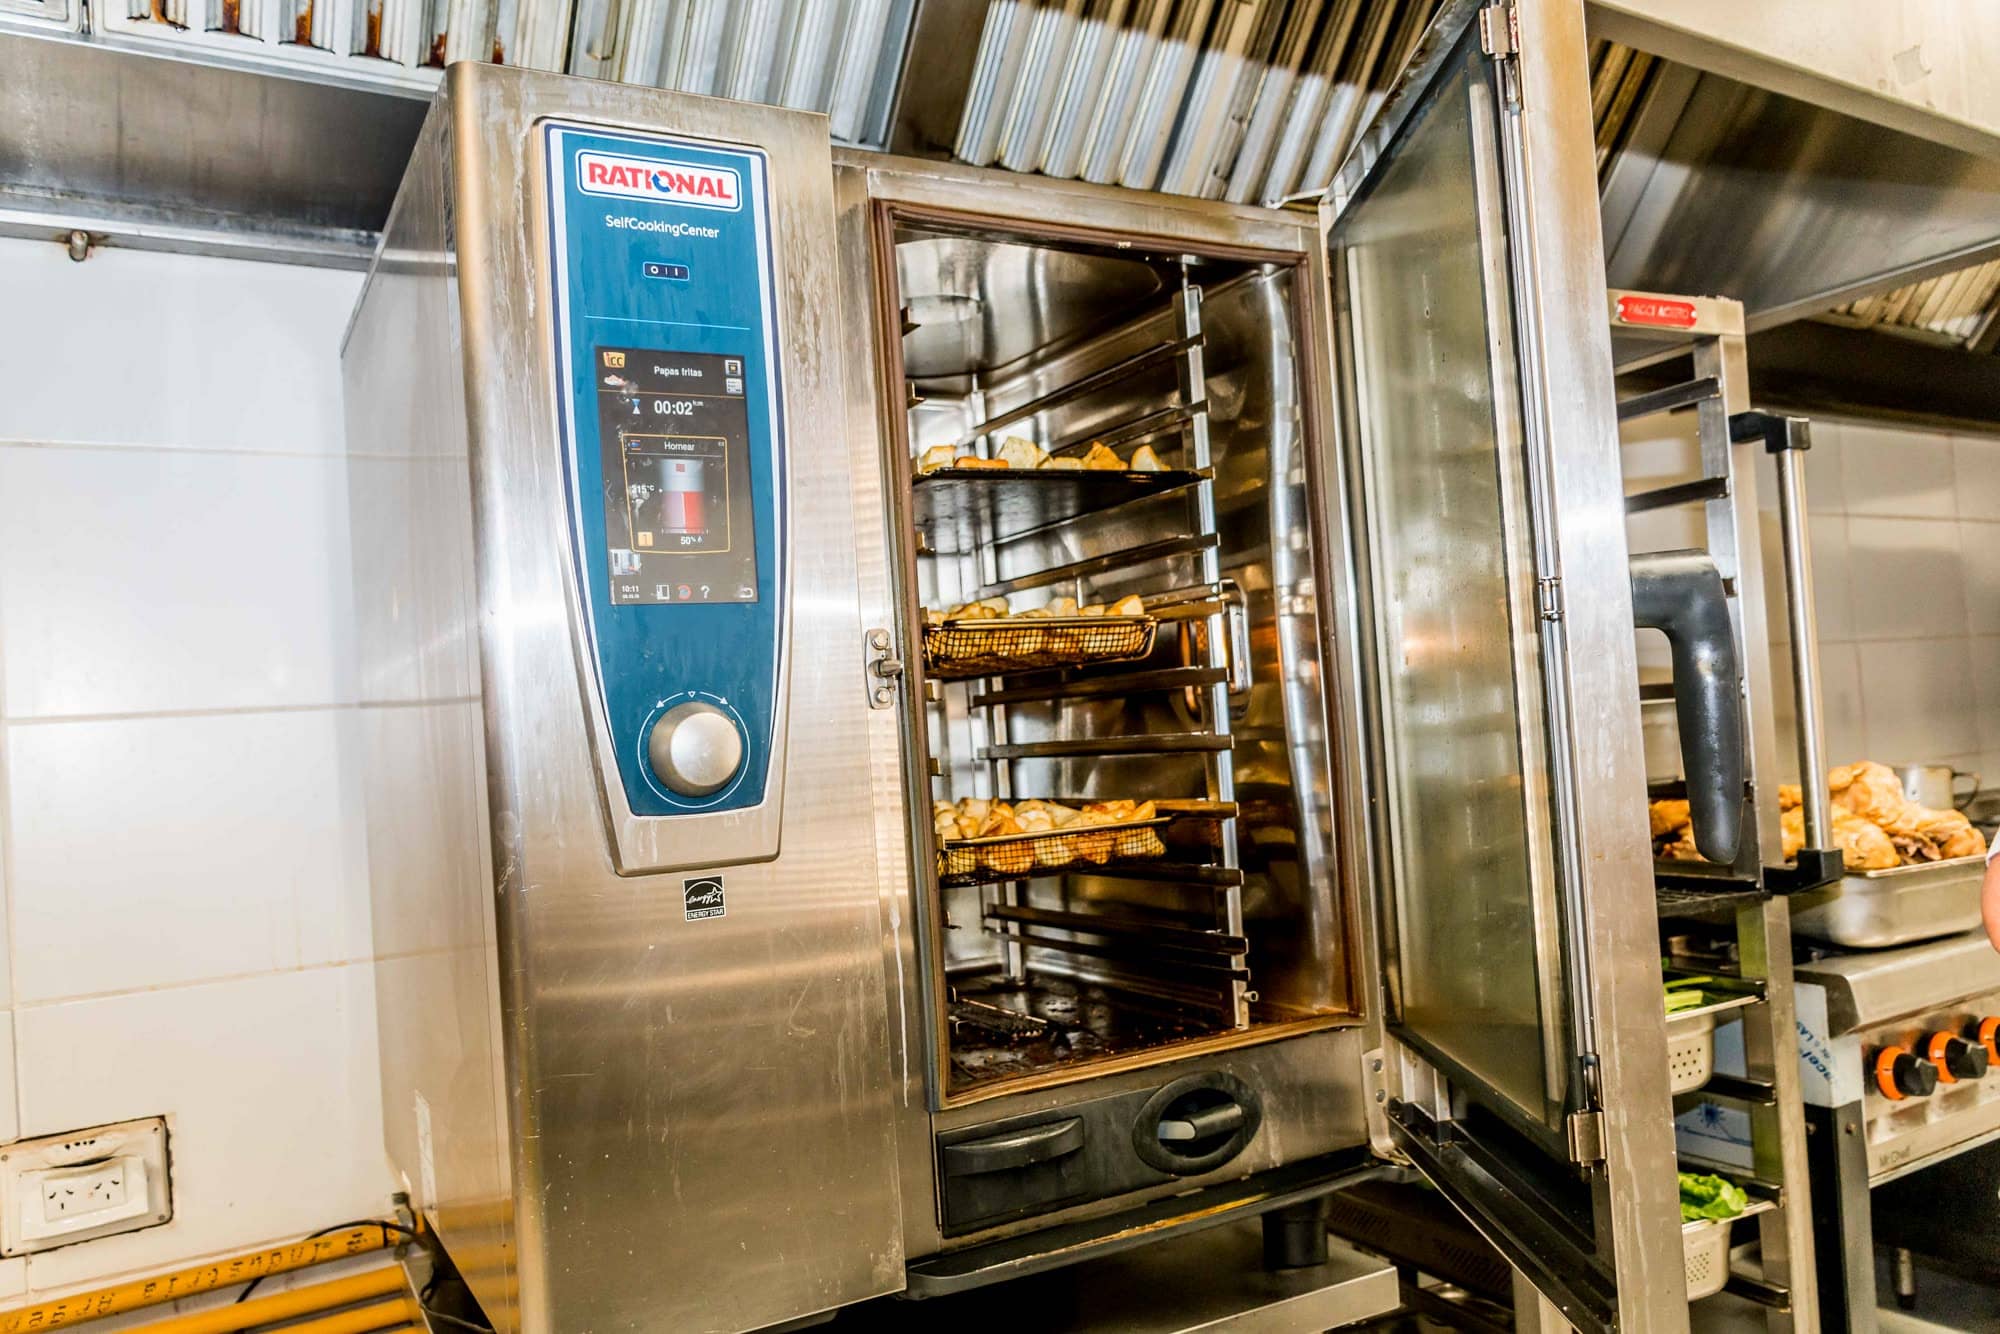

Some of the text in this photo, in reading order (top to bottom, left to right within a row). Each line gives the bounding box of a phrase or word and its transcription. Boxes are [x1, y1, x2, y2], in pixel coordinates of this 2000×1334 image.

[589, 163, 732, 199] RATIONAL
[605, 215, 720, 239] SelfCookingCenter
[654, 365, 703, 378] Papas fritas
[654, 400, 693, 415] 00:02
[664, 441, 696, 451] Hornear
